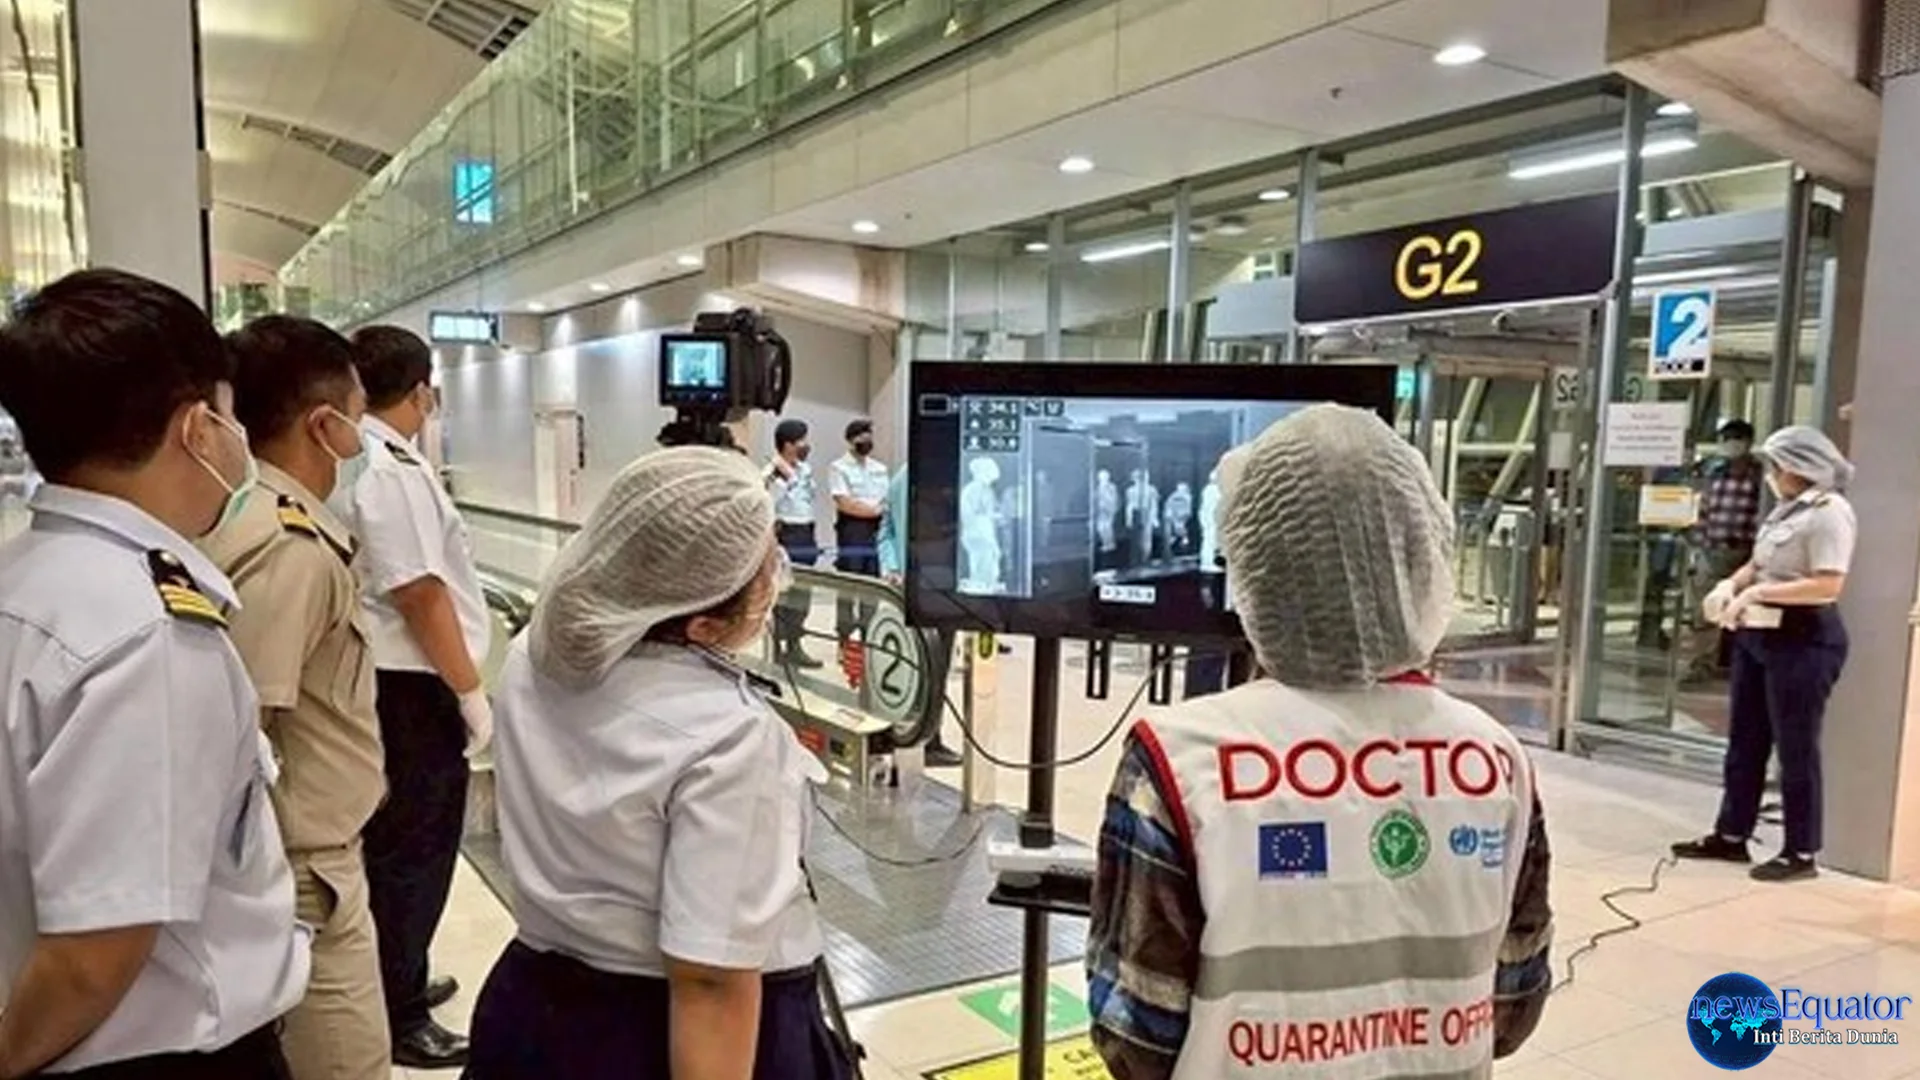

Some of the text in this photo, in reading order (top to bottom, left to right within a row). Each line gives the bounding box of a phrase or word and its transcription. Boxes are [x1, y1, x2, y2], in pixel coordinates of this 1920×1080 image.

[1396, 229, 1481, 299] G2
[1667, 297, 1709, 358] 2
[881, 632, 902, 695] 2
[1228, 1008, 1429, 1067] QUARANTINE
